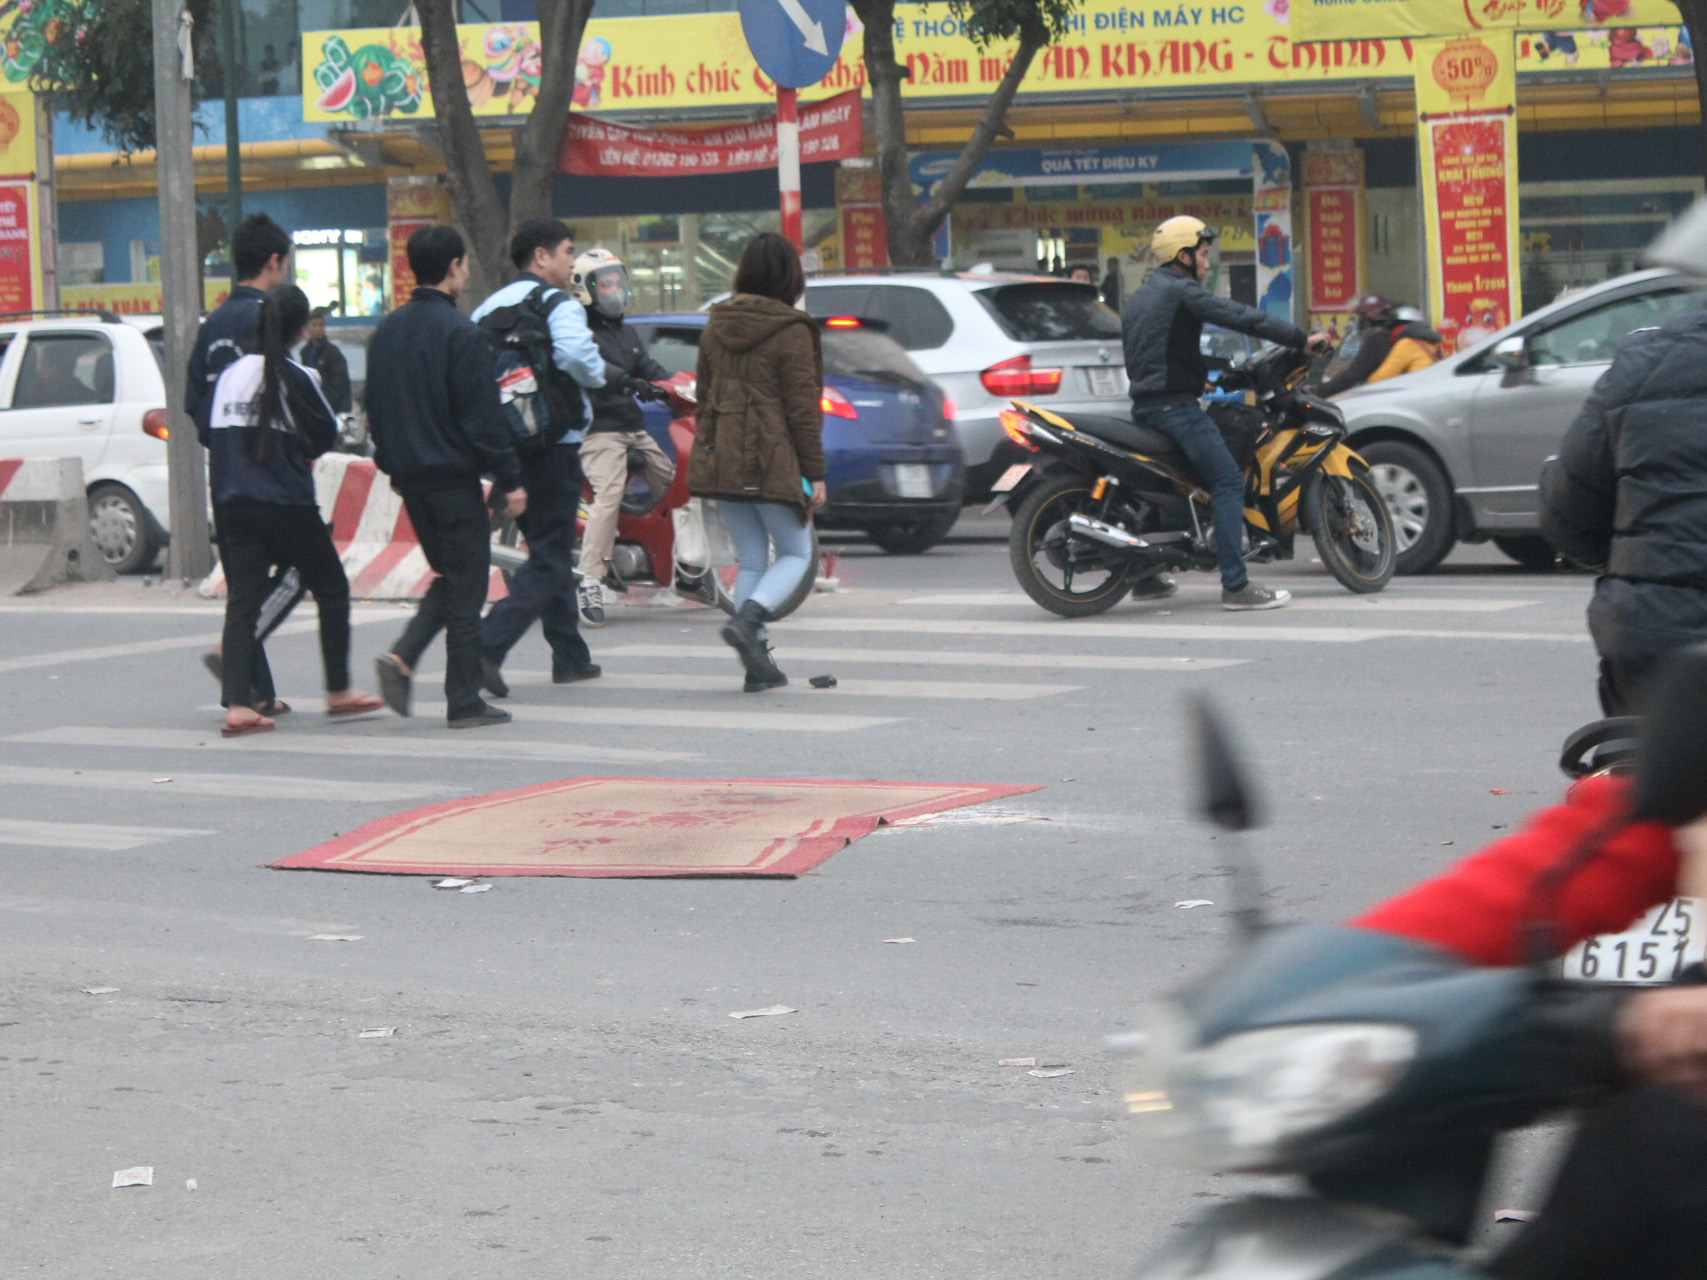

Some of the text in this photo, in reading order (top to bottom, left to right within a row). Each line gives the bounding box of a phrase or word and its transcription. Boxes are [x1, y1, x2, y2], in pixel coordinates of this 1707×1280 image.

[1094, 6, 1145, 34] ĐIỆN
[1153, 4, 1202, 27] MÁY
[1211, 6, 1245, 24] HC
[612, 63, 676, 98] Kính
[686, 61, 741, 94] chúc
[1580, 938, 1690, 979] 6151
